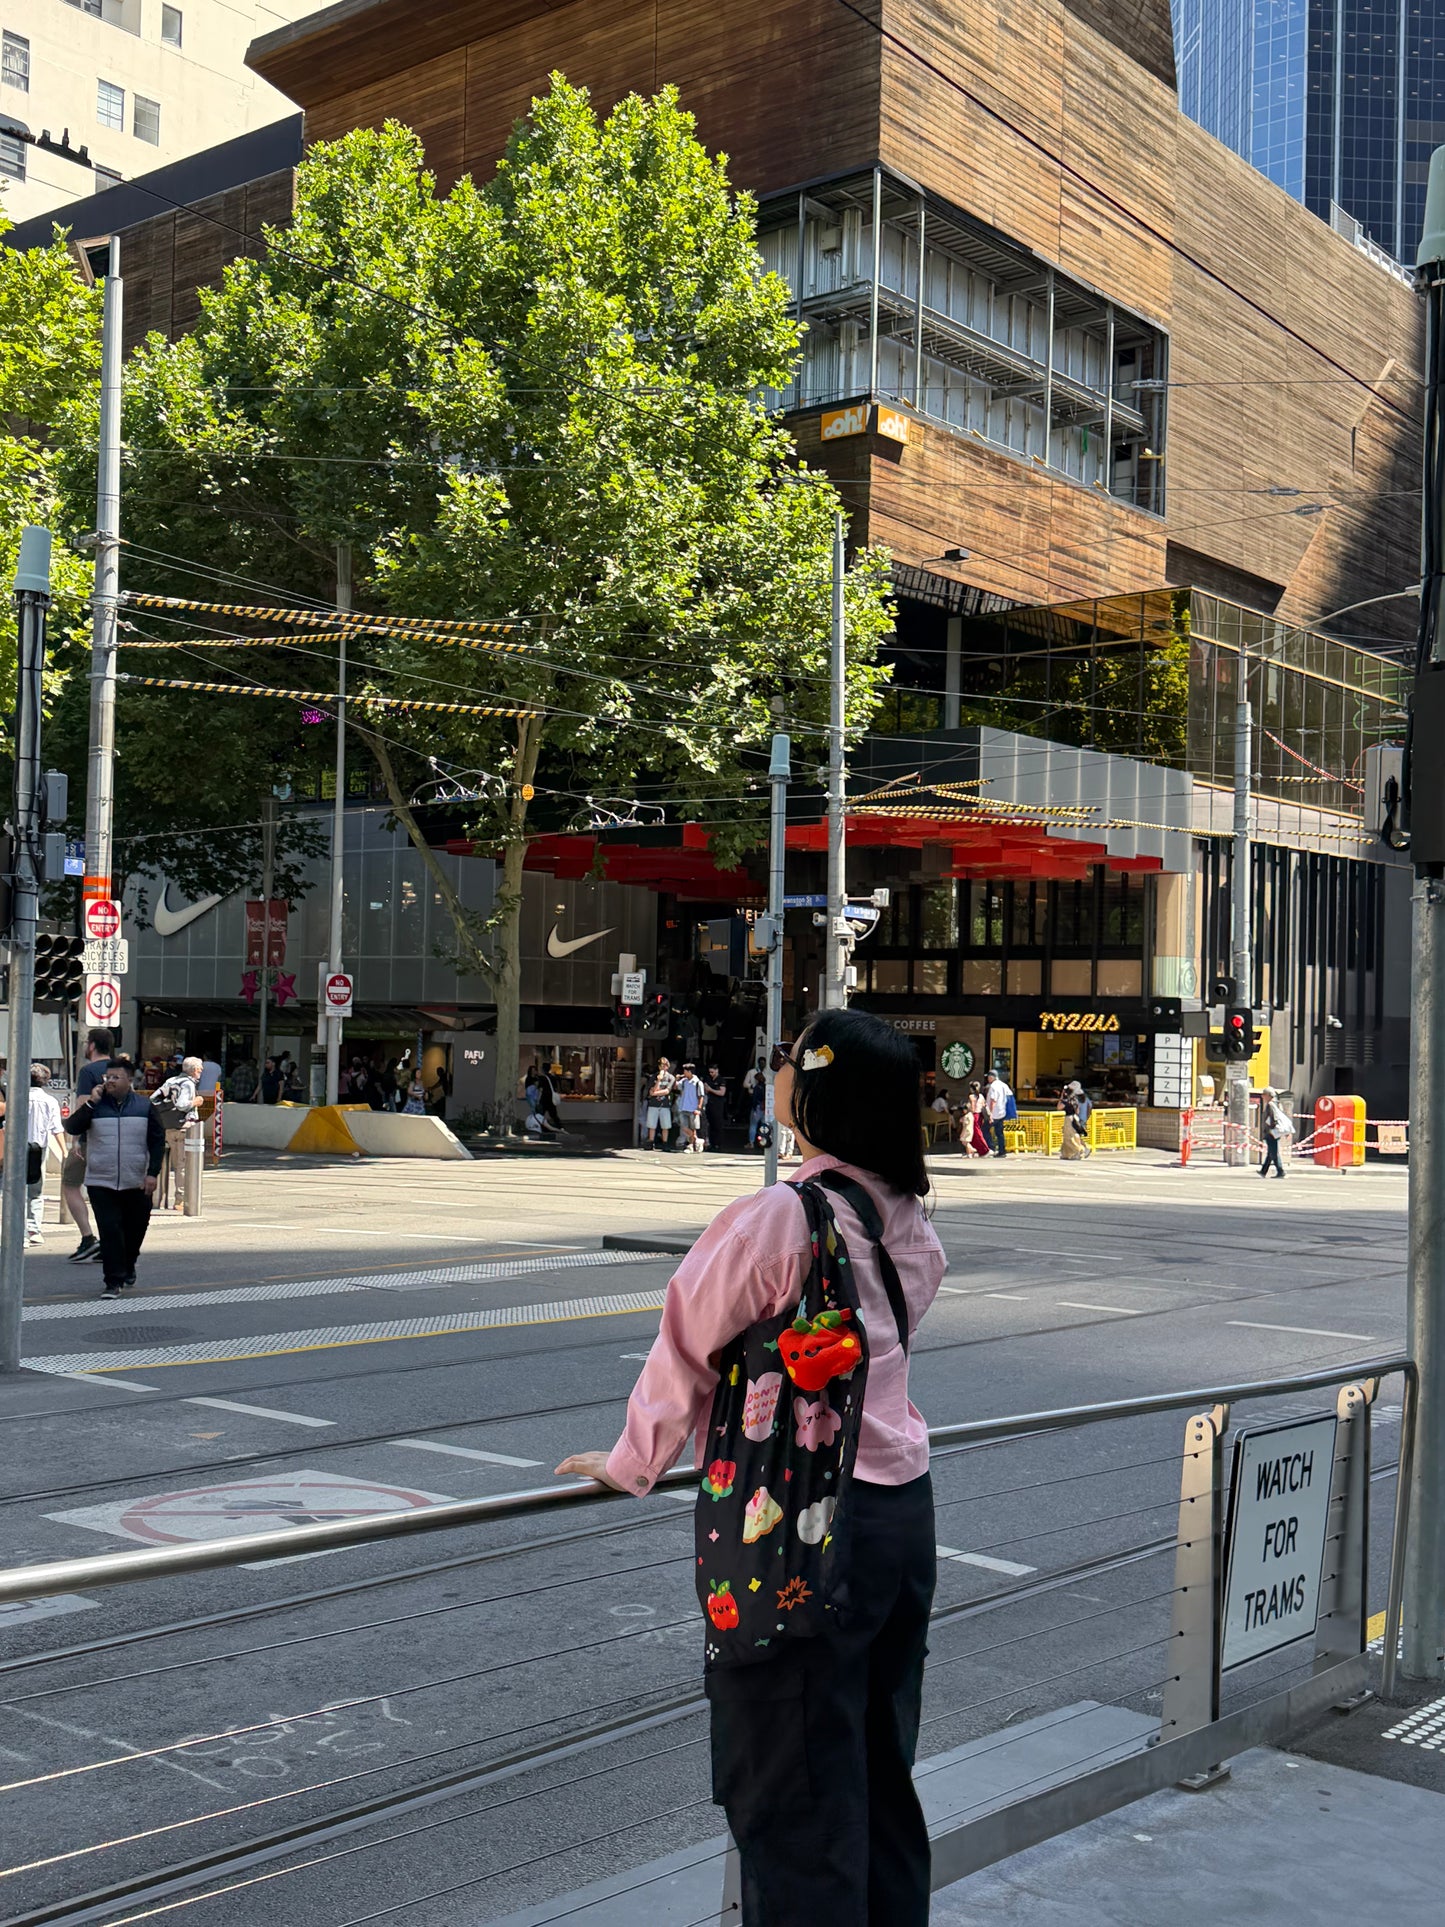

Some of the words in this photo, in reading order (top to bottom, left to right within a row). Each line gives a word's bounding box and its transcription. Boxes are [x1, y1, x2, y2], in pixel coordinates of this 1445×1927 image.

[97, 906, 109, 915] NO
[91, 923, 115, 933] ENTRY
[82, 951, 125, 961] BICYCLES
[93, 992, 113, 1009] 30
[893, 1020, 936, 1030] COFFEE
[464, 1049, 485, 1060] PAFU
[1256, 1450, 1314, 1502] WATCH
[1262, 1516, 1299, 1563] FOR
[1244, 1574, 1306, 1633] TRAMS
